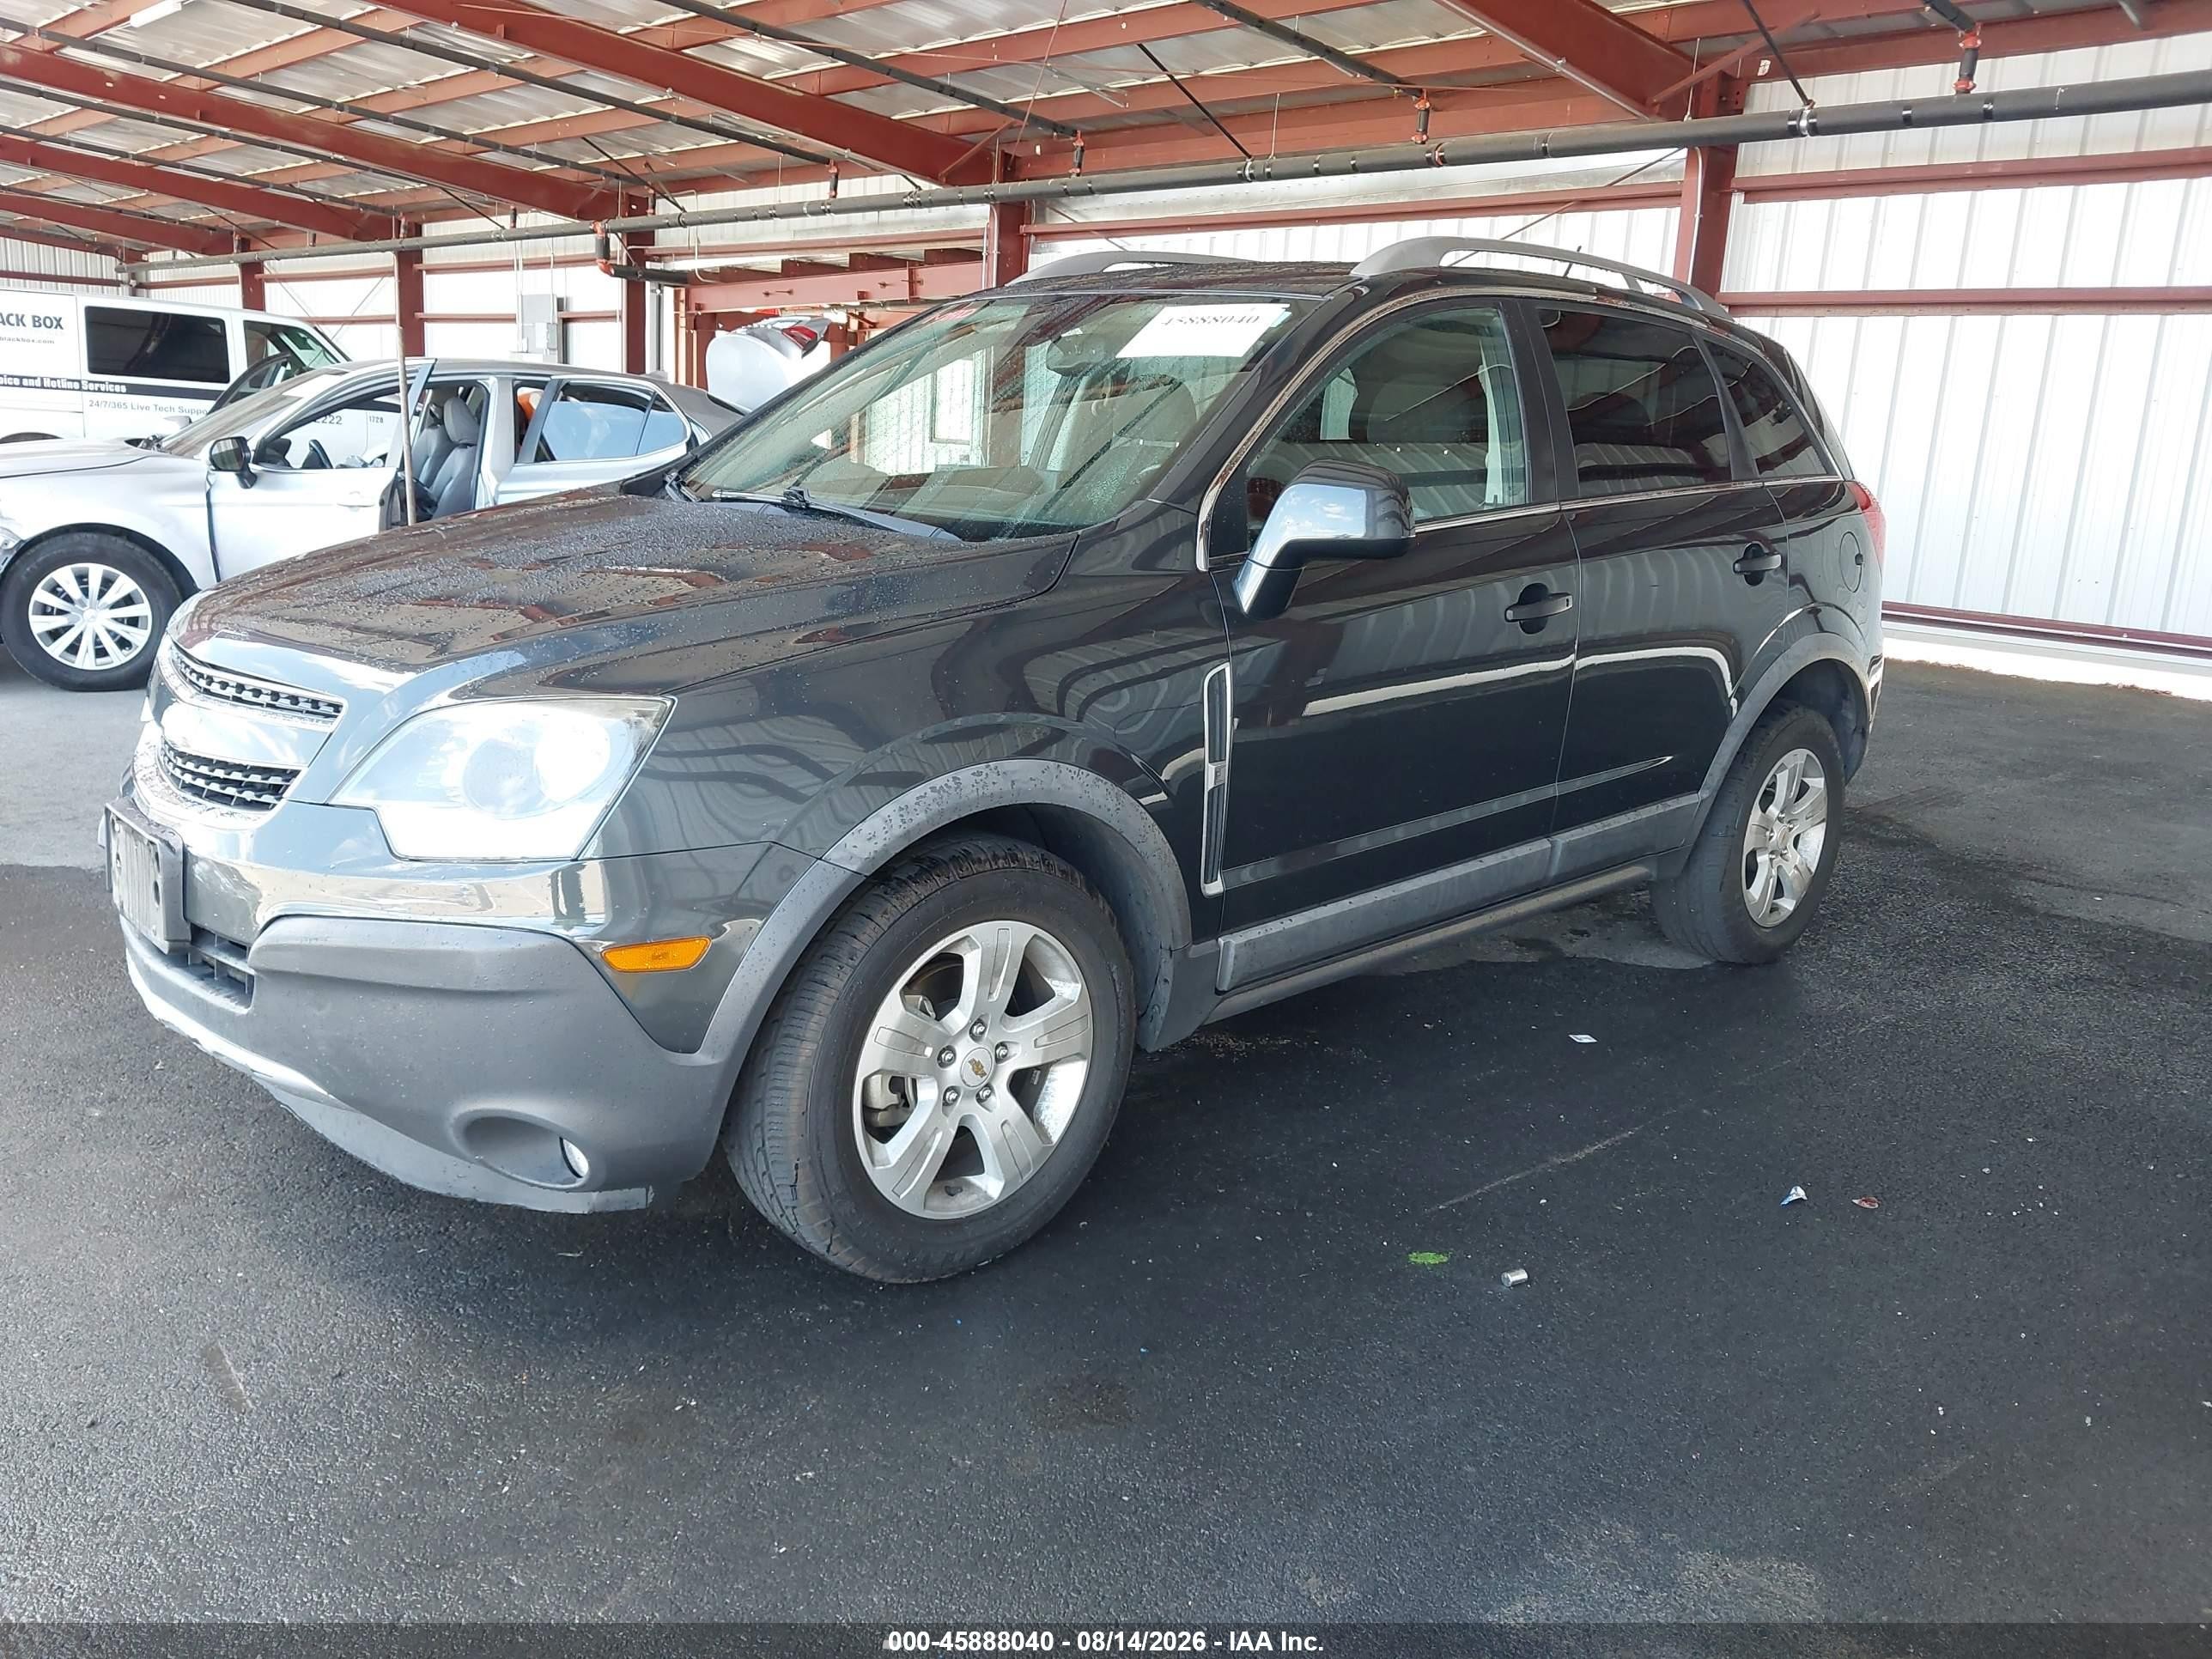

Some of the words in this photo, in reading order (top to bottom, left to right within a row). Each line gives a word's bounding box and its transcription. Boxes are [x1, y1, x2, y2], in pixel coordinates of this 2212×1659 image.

[32, 314, 65, 330] BOX
[21, 376, 41, 387] and
[43, 376, 80, 390] Hotline
[81, 380, 127, 392] Services
[88, 399, 128, 410] 24/7/365
[131, 403, 150, 411] Live
[153, 404, 175, 413] Tech
